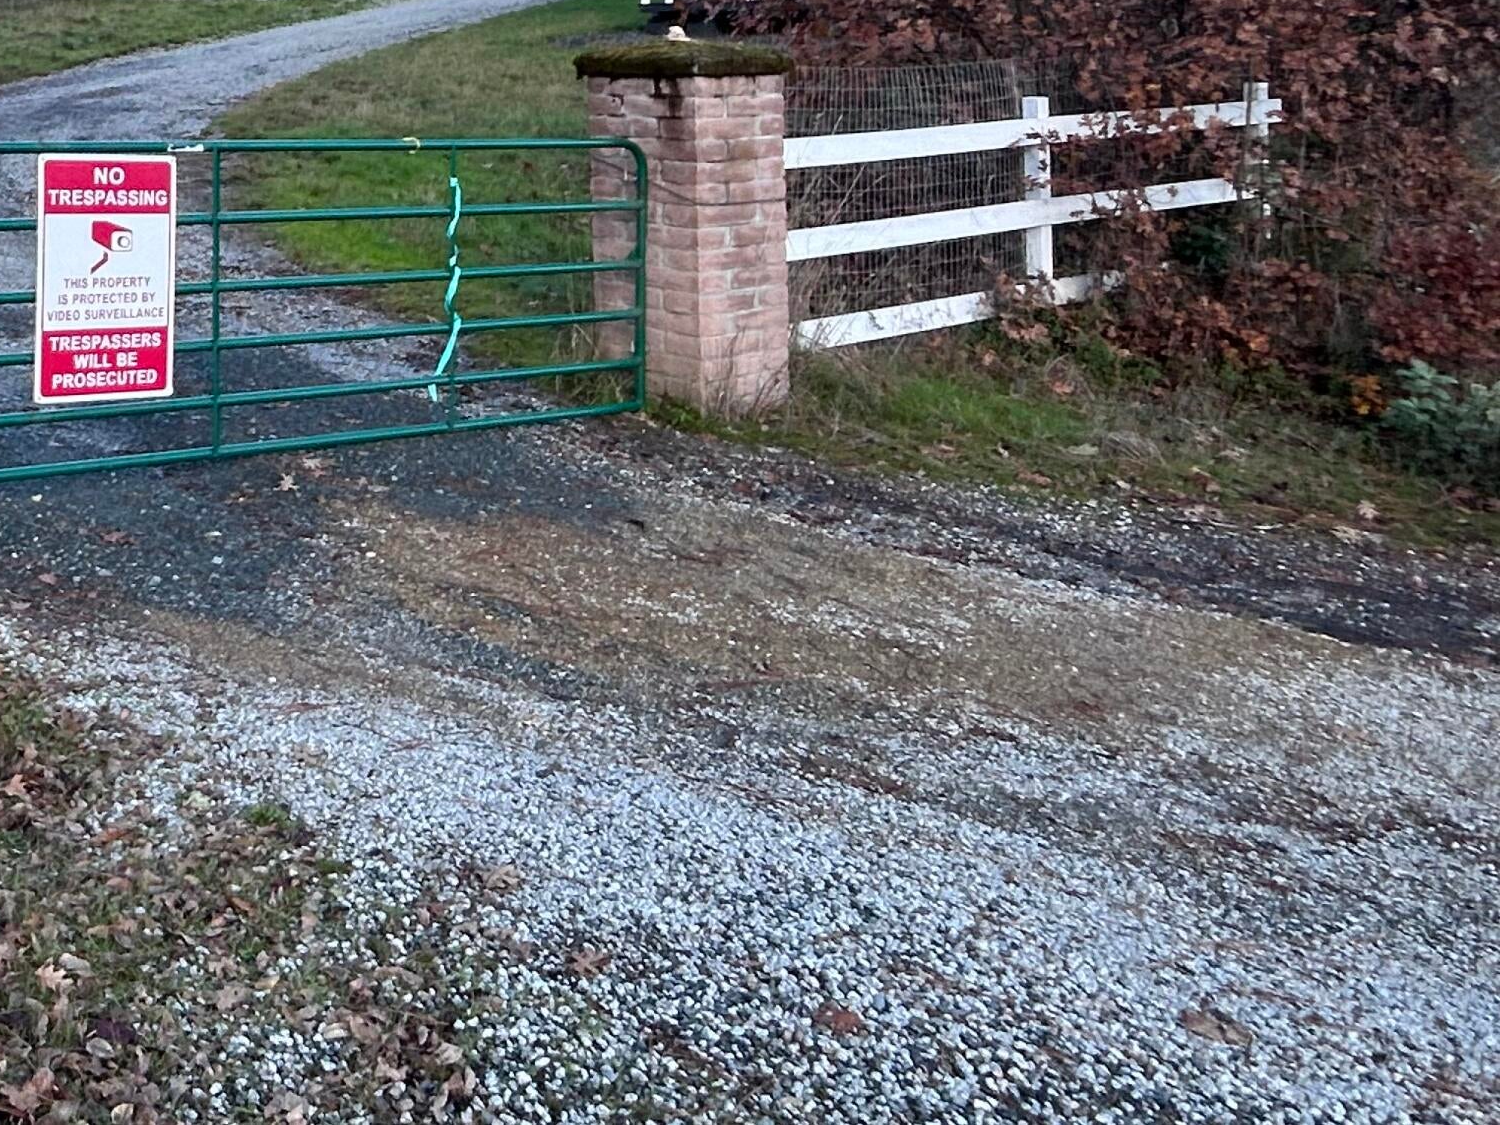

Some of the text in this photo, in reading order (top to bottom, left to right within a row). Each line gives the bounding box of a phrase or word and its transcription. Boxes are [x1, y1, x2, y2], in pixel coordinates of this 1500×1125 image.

[93, 167, 125, 185] NO
[48, 189, 168, 206] TRESPASSING
[63, 277, 151, 289] THIS PROPERTY
[58, 292, 156, 305] IS PROTECTED BY
[47, 307, 165, 322] VIDEO SURVEILLANCE
[49, 332, 162, 351] TRESPASSERS
[73, 352, 138, 369] WILL BE
[51, 369, 158, 390] PROSECUTED
